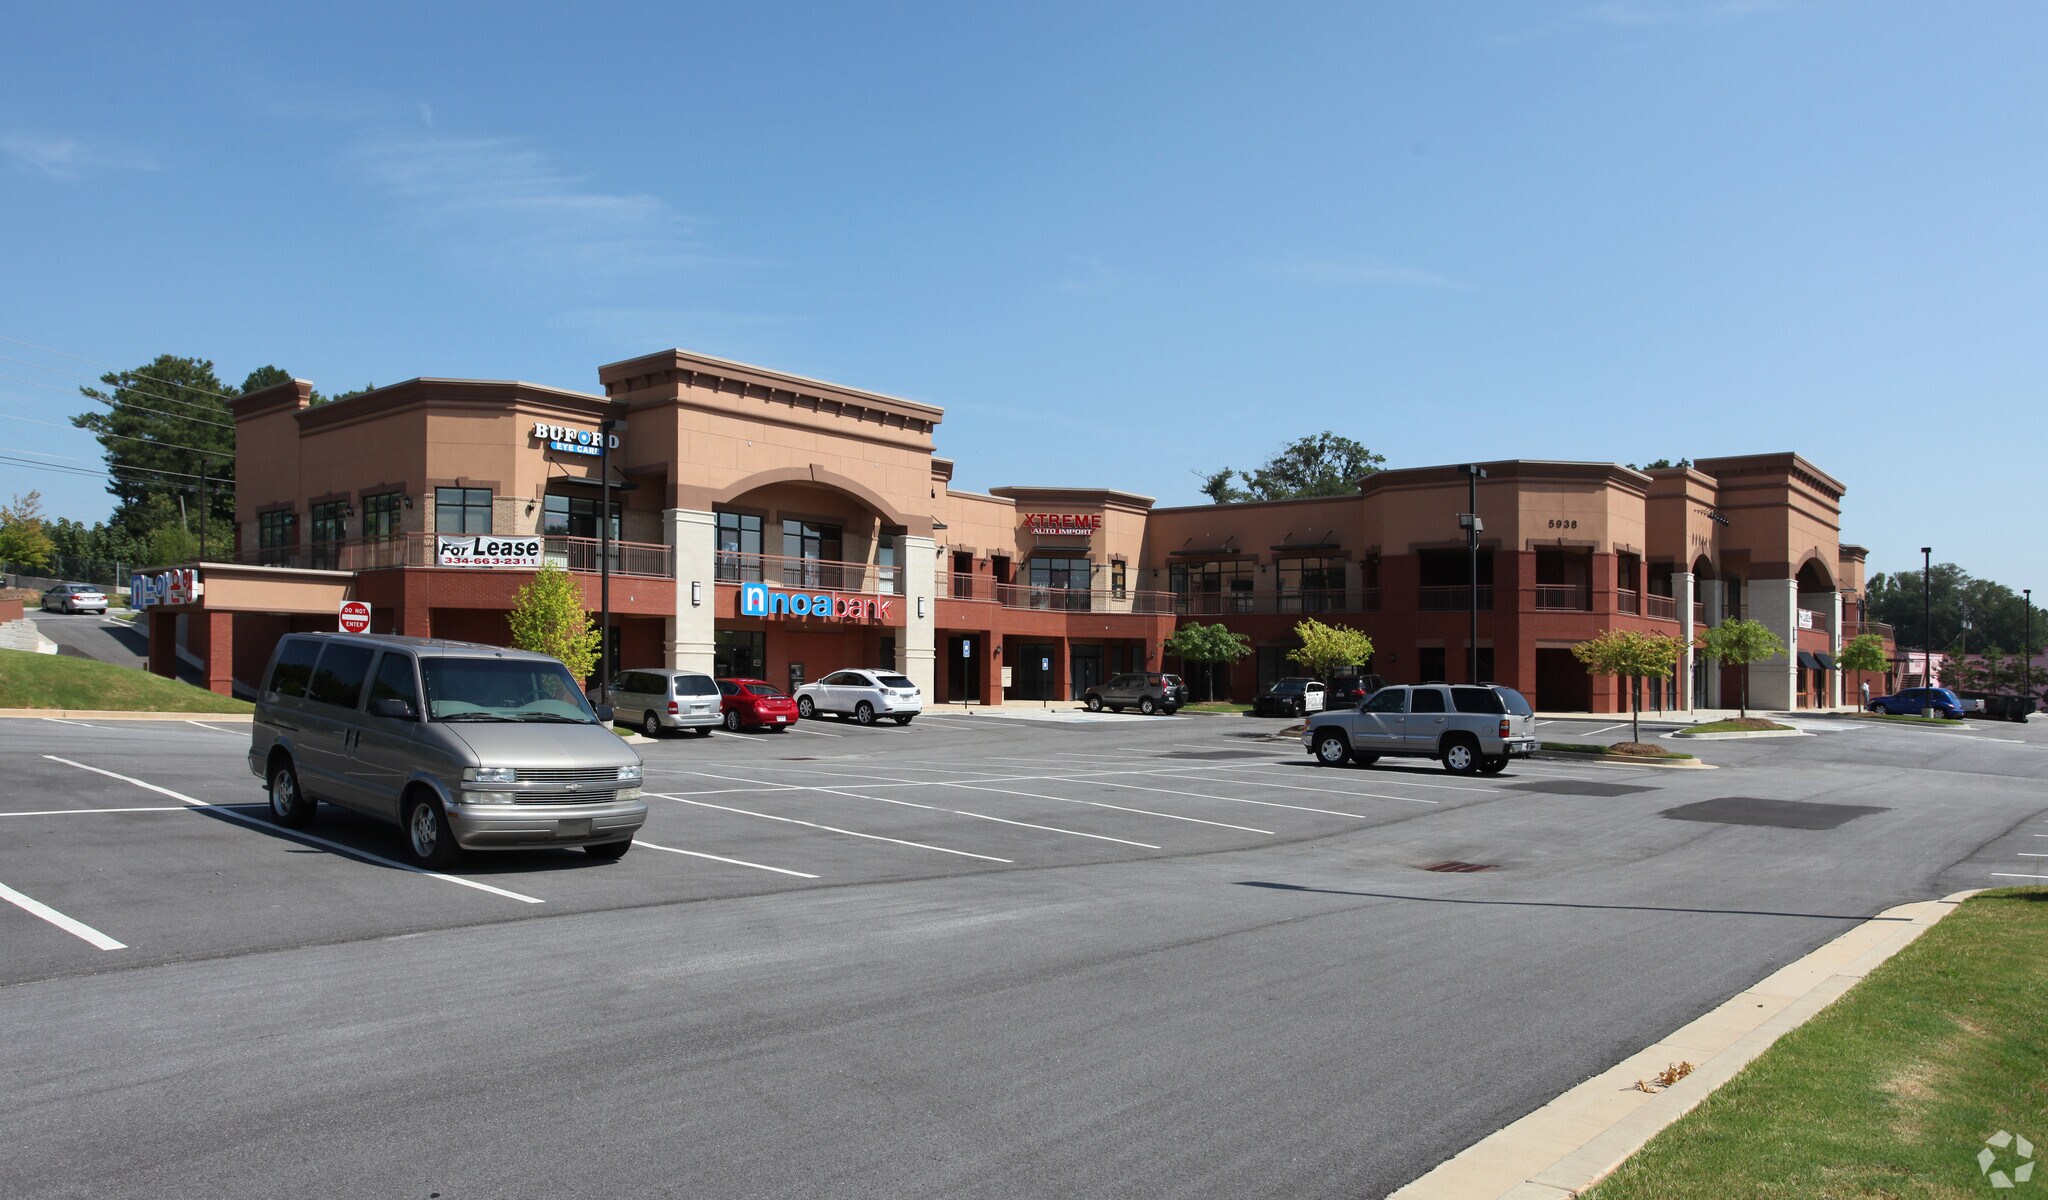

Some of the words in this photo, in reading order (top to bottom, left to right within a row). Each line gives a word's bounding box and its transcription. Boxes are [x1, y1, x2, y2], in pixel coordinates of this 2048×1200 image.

[533, 422, 620, 449] BUFORD
[556, 442, 575, 452] EYE
[576, 445, 600, 456] CARE
[1023, 513, 1102, 529] XTREME
[1548, 519, 1578, 530] 5938
[1032, 527, 1057, 535] AUTO
[1058, 527, 1092, 536] IMPORT
[439, 543, 469, 556] For
[472, 537, 539, 557] Lease
[444, 557, 535, 566] 334-663-2311
[769, 590, 894, 620] noabank
